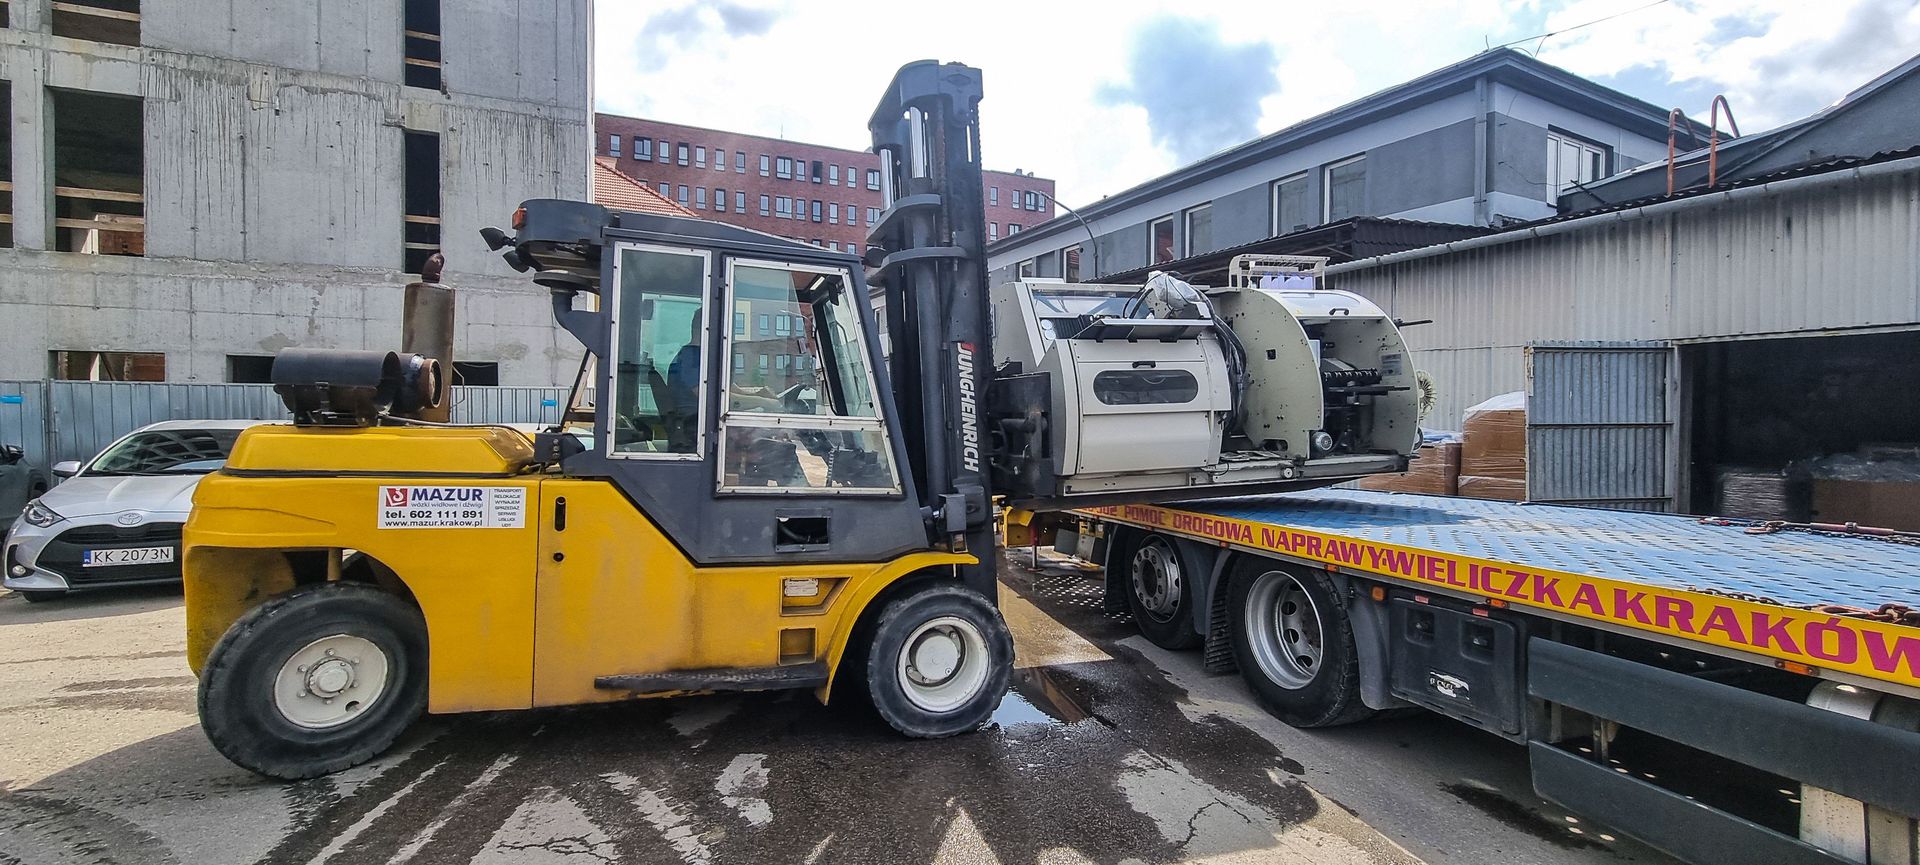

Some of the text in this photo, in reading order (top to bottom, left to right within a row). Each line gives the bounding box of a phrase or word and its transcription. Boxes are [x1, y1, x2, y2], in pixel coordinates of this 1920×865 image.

[957, 342, 979, 472] JUNGHEINRICH
[411, 488, 483, 501] MAZUR
[463, 501, 483, 509] dźwigi
[385, 510, 483, 519] tel. 602 111 891
[385, 519, 483, 528] www.mazur.krakow.pl
[1125, 505, 1167, 526] POMOC
[1172, 513, 1254, 544] DROGOWA
[94, 548, 170, 563] KK 2073N
